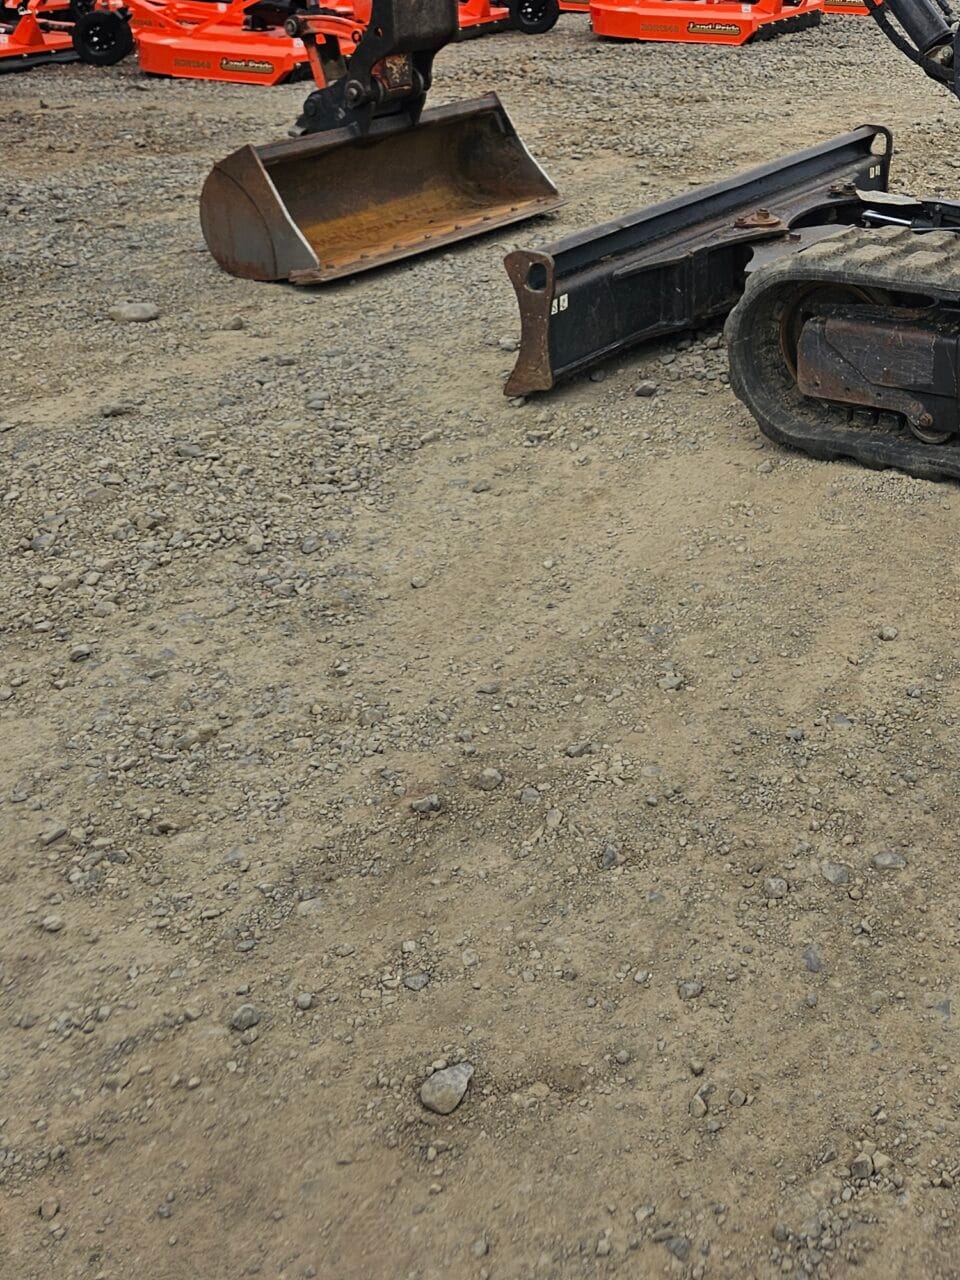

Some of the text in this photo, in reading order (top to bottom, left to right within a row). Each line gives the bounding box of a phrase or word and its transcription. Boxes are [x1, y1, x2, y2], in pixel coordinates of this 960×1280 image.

[689, 22, 741, 32] Land Pride
[222, 58, 274, 69] Land Pride
